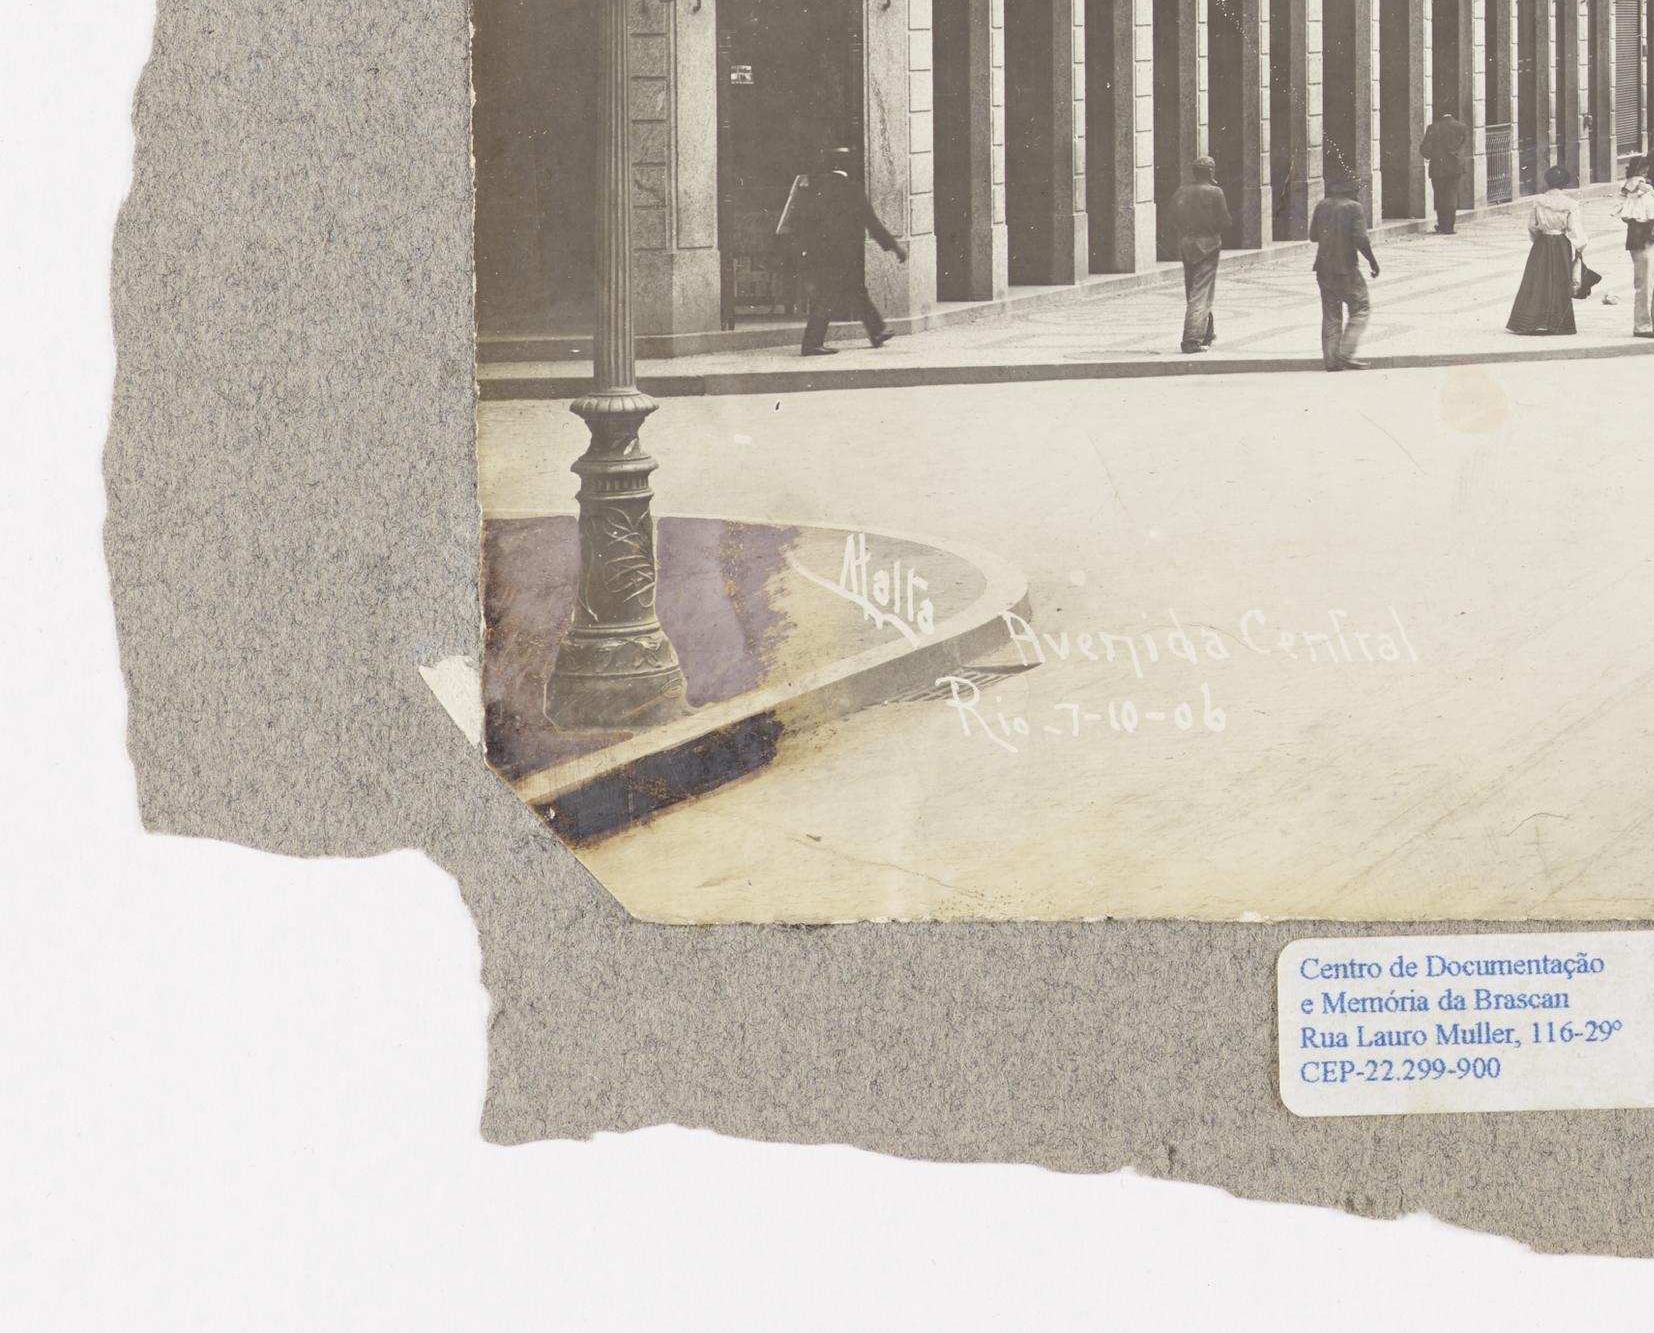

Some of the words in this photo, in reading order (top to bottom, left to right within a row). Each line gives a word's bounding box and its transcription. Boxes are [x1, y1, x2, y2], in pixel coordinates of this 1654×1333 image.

[1300, 957, 1382, 980] Centro
[1389, 955, 1418, 978] de
[1425, 952, 1605, 980] Documentação
[1300, 999, 1314, 1015] e
[1321, 990, 1430, 1015] Memória
[1438, 989, 1467, 1011] da
[1473, 989, 1570, 1011] Brascan
[1300, 1027, 1349, 1048] Rua
[1356, 1025, 1428, 1048] Lauro
[1435, 1022, 1522, 1048] Muller,
[1532, 1019, 1623, 1044] 116-29º
[1300, 1056, 1500, 1083] CEP-22.299-900
